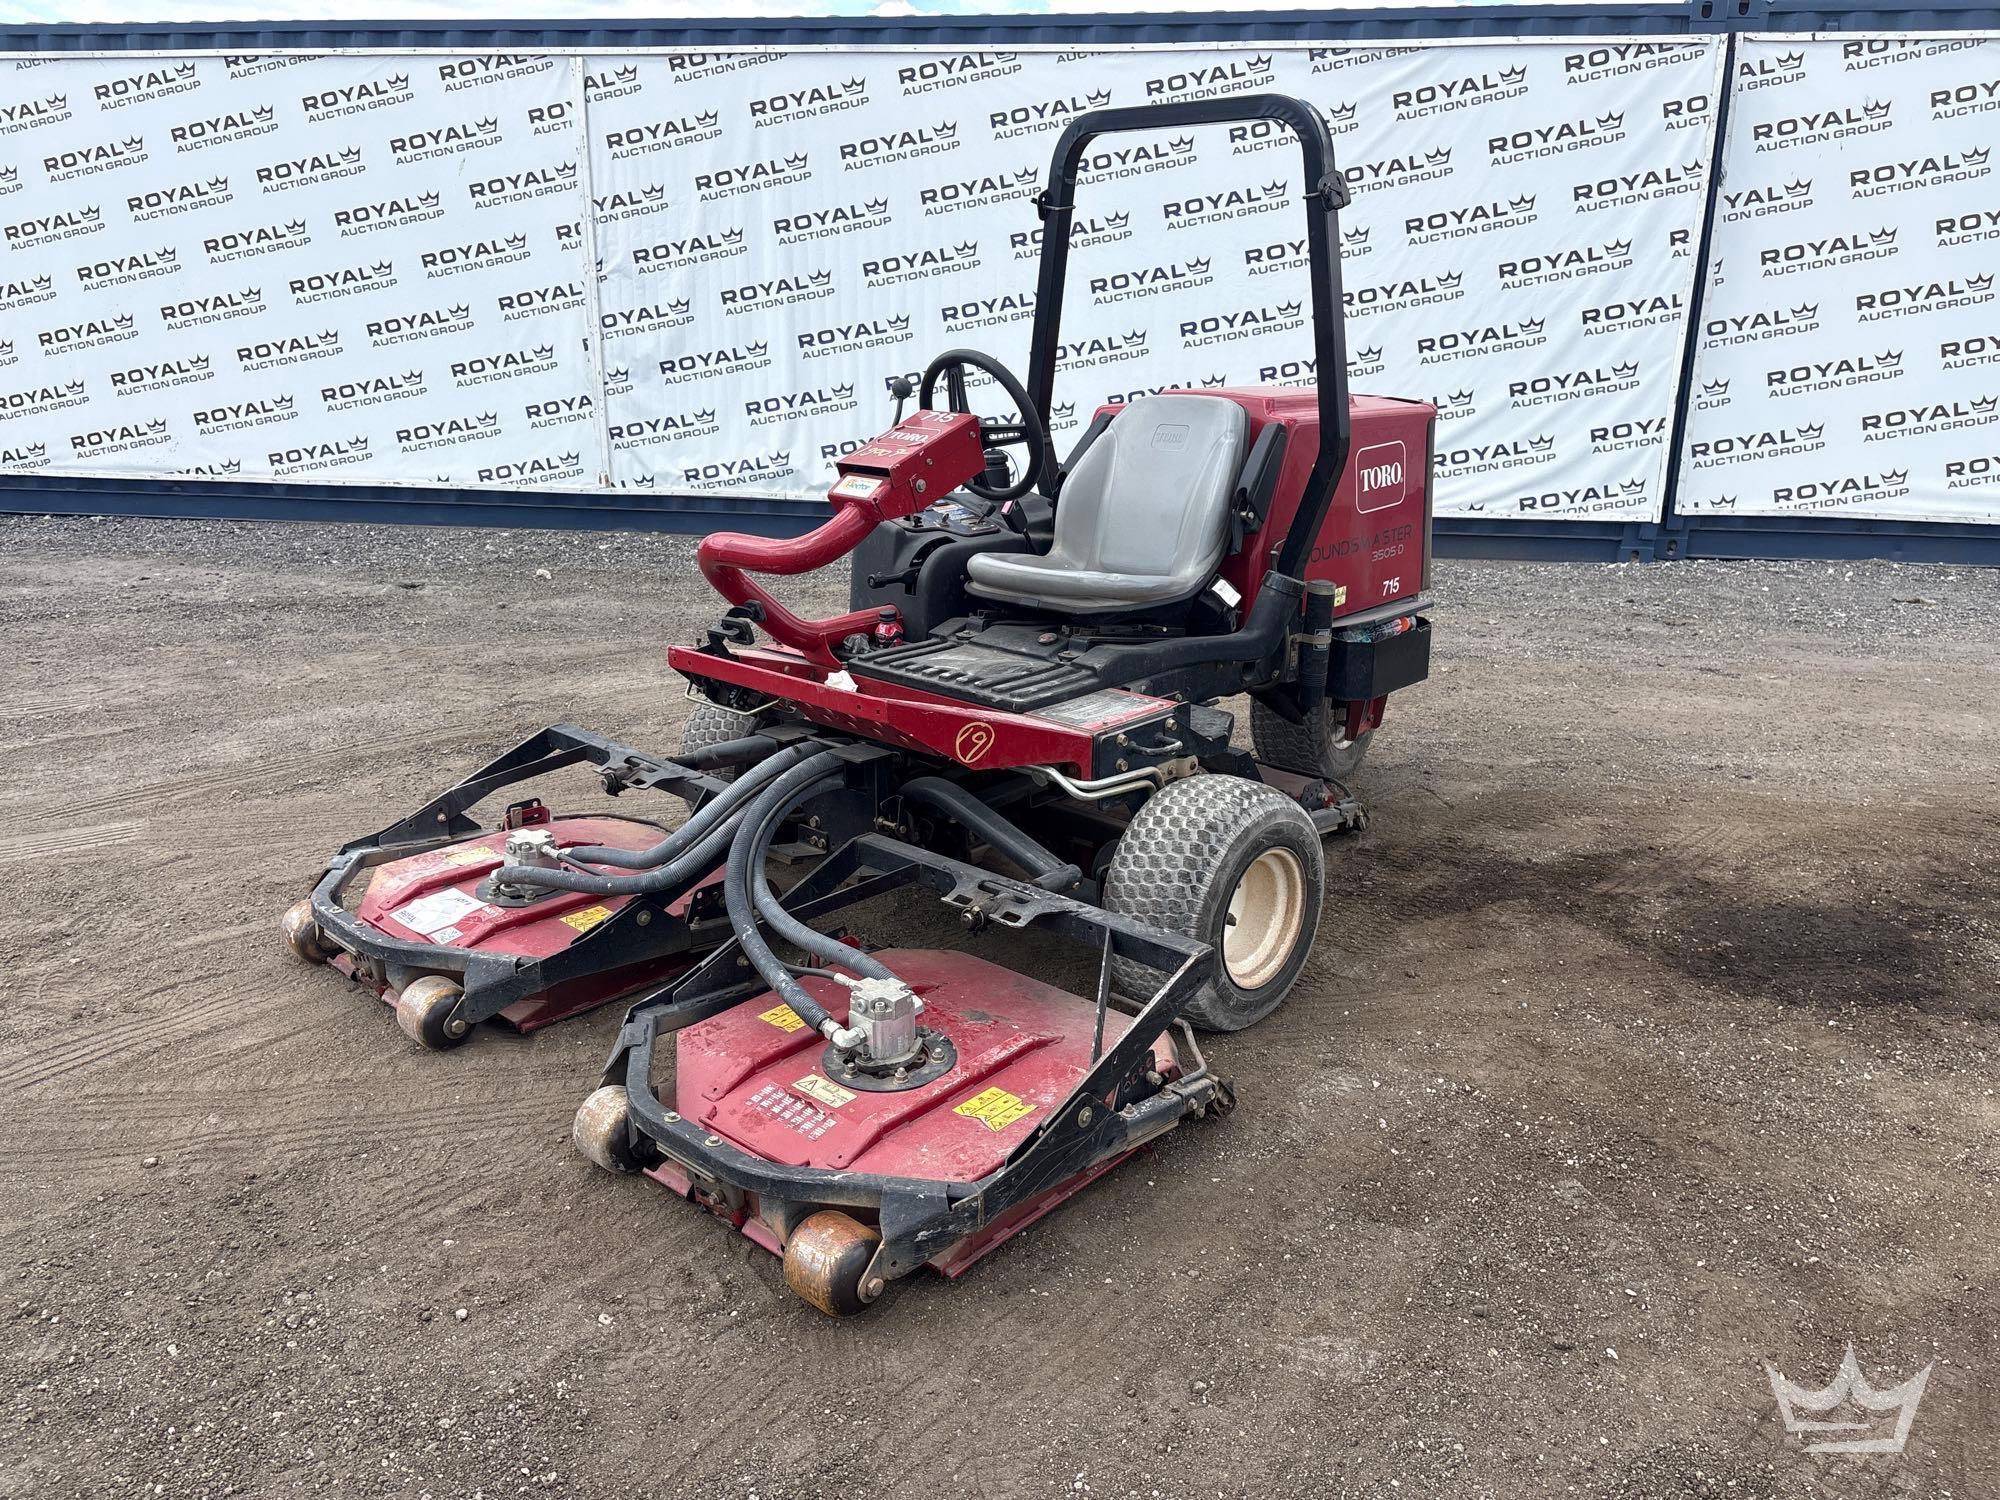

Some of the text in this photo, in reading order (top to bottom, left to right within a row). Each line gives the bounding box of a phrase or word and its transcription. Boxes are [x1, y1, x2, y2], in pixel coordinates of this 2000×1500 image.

[94, 70, 176, 100] ROYAL
[101, 80, 201, 111] AUCTION GROUP
[302, 81, 388, 112] ROYAL
[1393, 74, 1498, 109] ROYAL
[309, 92, 414, 123] AUCTION GROUP
[749, 85, 842, 117] ROYAL
[755, 97, 869, 129] AUCTION GROUP
[1396, 86, 1528, 122] AUCTION GROUP
[171, 112, 254, 142] ROYAL
[177, 123, 278, 153] AUCTION GROUP
[390, 124, 477, 154] ROYAL
[606, 118, 696, 149] ROYAL
[1488, 120, 1595, 154] ROYAL
[1753, 108, 1862, 141] ROYAL
[1755, 121, 1892, 153] AUCTION GROUP
[43, 143, 124, 172] ROYAL
[396, 136, 502, 165] AUCTION GROUP
[612, 129, 722, 160] AUCTION GROUP
[840, 129, 933, 160] ROYAL
[844, 140, 960, 171] AUCTION GROUP
[1491, 132, 1625, 167] AUCTION GROUP
[50, 154, 148, 183] AUCTION GROUP
[256, 154, 341, 183] ROYAL
[263, 165, 366, 194] AUCTION GROUP
[695, 160, 785, 191] ROYAL
[1850, 155, 1960, 187] ROYAL
[1852, 167, 1991, 199] AUCTION GROUP
[127, 183, 209, 212] ROYAL
[700, 172, 812, 202] AUCTION GROUP
[920, 175, 1014, 205] ROYAL
[925, 186, 1041, 216] AUCTION GROUP
[134, 194, 233, 223] AUCTION GROUP
[334, 198, 419, 226] ROYAL
[1163, 188, 1261, 219] ROYAL
[1167, 200, 1289, 231] AUCTION GROUP
[1405, 202, 1508, 234] ROYAL
[4, 212, 82, 240] ROYAL
[341, 209, 444, 238] AUCTION GROUP
[774, 205, 865, 234] ROYAL
[779, 216, 892, 246] AUCTION GROUP
[1408, 214, 1537, 246] AUCTION GROUP
[11, 223, 105, 251] AUCTION GROUP
[632, 235, 722, 264] ROYAL
[1761, 235, 1868, 266] ROYAL
[77, 254, 157, 281] ROYAL
[421, 240, 506, 268] ROYAL
[427, 251, 531, 279] AUCTION GROUP
[638, 246, 747, 275] AUCTION GROUP
[862, 248, 954, 277] ROYAL
[1499, 247, 1603, 279] ROYAL
[1762, 247, 1898, 278] AUCTION GROUP
[84, 264, 181, 292] AUCTION GROUP
[289, 267, 373, 294] ROYAL
[867, 260, 981, 288] AUCTION GROUP
[1090, 264, 1186, 294] ROYAL
[1501, 259, 1633, 291] AUCTION GROUP
[296, 278, 397, 305] AUCTION GROUP
[720, 276, 809, 305] ROYAL
[726, 288, 835, 316] AUCTION GROUP
[1094, 276, 1213, 306] AUCTION GROUP
[1856, 281, 1964, 311] ROYAL
[160, 294, 242, 320] ROYAL
[167, 304, 266, 331] AUCTION GROUP
[1858, 293, 1995, 323] AUCTION GROUP
[798, 321, 887, 348] ROYAL
[1180, 308, 1276, 337] ROYAL
[1183, 320, 1304, 349] AUCTION GROUP
[237, 336, 319, 362] ROYAL
[803, 332, 913, 359] AUCTION GROUP
[1417, 325, 1518, 354] ROYAL
[1420, 336, 1547, 365] AUCTION GROUP
[243, 347, 343, 372] AUCTION GROUP
[451, 351, 534, 377] ROYAL
[659, 348, 747, 375] ROYAL
[665, 359, 771, 385] AUCTION GROUP
[1767, 357, 1874, 386] ROYAL
[321, 376, 403, 402] ROYAL
[456, 362, 558, 388] AUCTION GROUP
[1509, 369, 1611, 398] ROYAL
[1769, 369, 1904, 398] AUCTION GROUP
[327, 387, 427, 412] AUCTION GROUP
[745, 389, 832, 416] ROYAL
[1511, 380, 1640, 409] AUCTION GROUP
[608, 414, 694, 440] ROYAL
[750, 401, 858, 426] AUCTION GROUP
[920, 411, 959, 423] 715
[1862, 402, 1969, 431] ROYAL
[70, 424, 148, 449] ROYAL
[396, 418, 478, 443] ROYAL
[402, 429, 502, 453] AUCTION GROUP
[614, 426, 719, 450] AUCTION GROUP
[1864, 415, 1999, 443] AUCTION GROUP
[77, 435, 171, 459] AUCTION GROUP
[1691, 430, 1796, 458] ROYAL
[1693, 442, 1825, 469] AUCTION GROUP
[1360, 461, 1402, 492] TORO
[1310, 525, 1413, 563] OUNDSMASTER
[1382, 577, 1400, 596] 715
